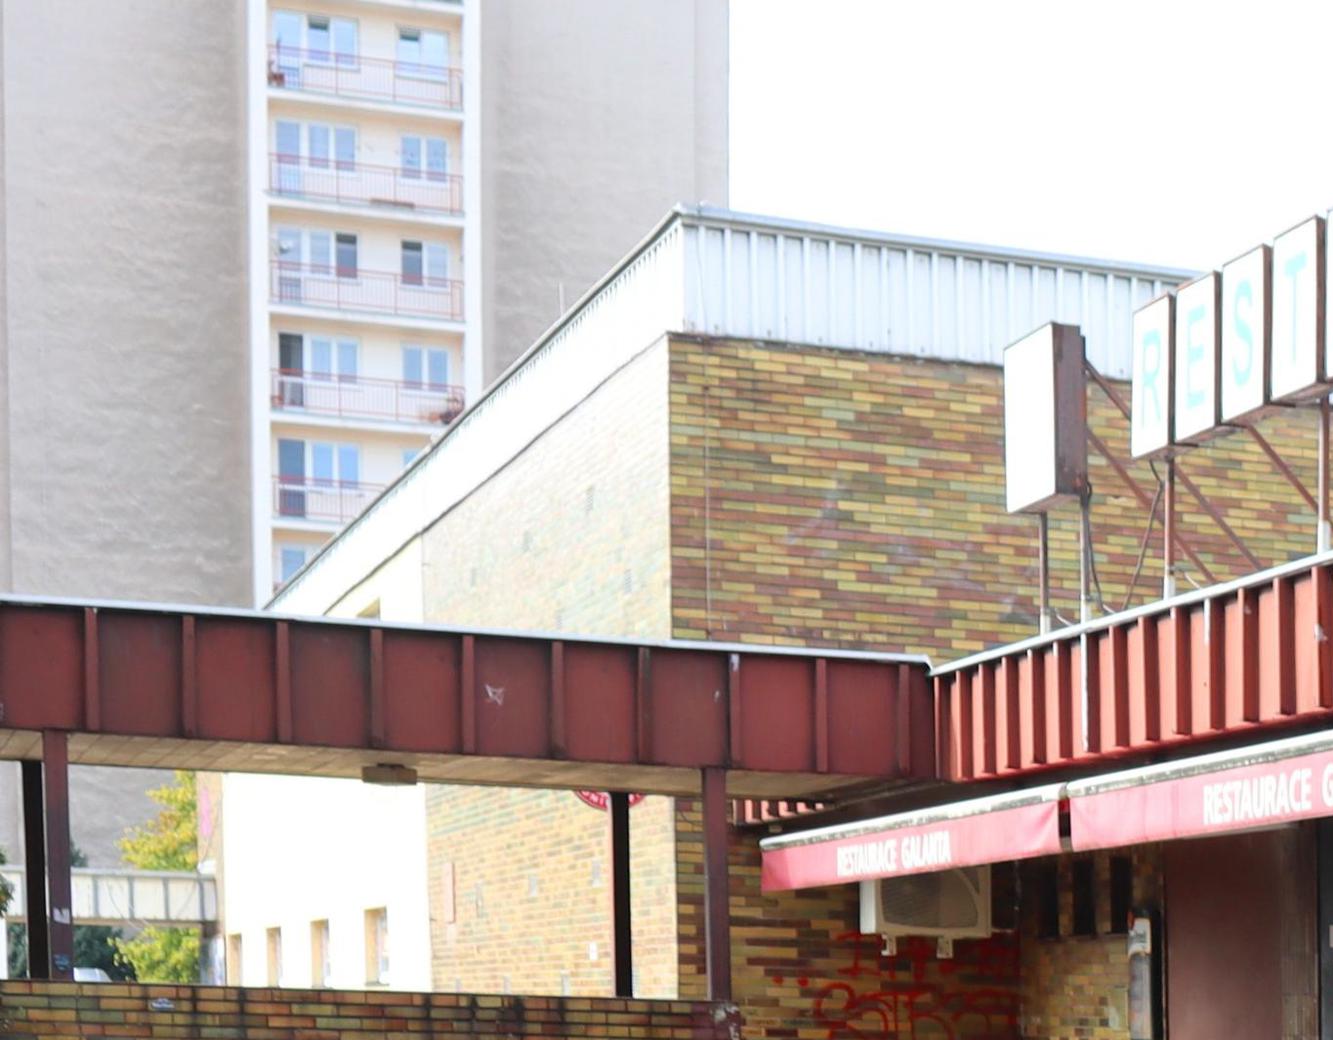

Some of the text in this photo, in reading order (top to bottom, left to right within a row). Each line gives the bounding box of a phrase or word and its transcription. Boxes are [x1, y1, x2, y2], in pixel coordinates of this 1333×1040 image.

[1203, 768, 1312, 825] RESTAURACE
[836, 829, 952, 877] RESTAURACE GALANTA
